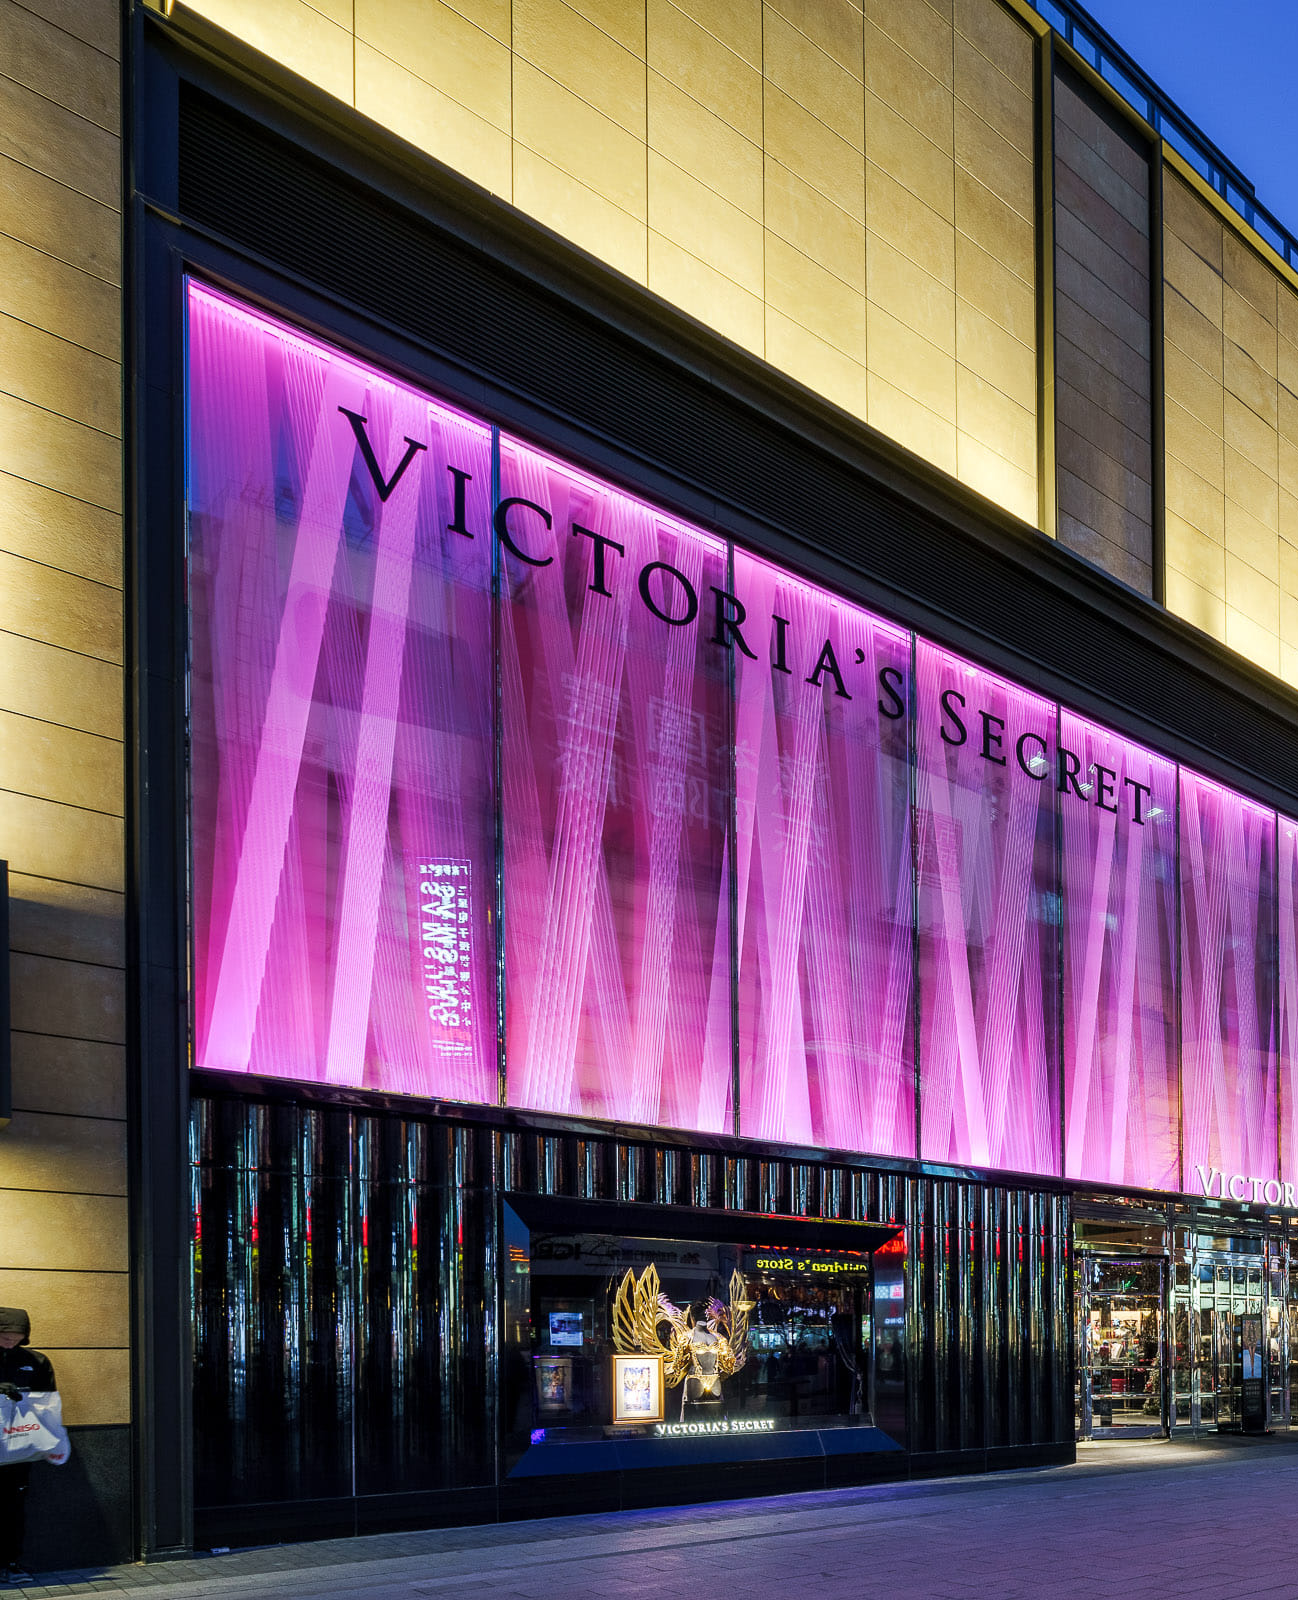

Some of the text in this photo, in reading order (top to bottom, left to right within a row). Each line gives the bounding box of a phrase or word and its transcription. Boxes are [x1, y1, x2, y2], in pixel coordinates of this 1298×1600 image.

[338, 406, 905, 721] VICTORIA'S
[940, 690, 1151, 826] SECRET
[656, 1420, 775, 1435] VICTORIA'S SECRET
